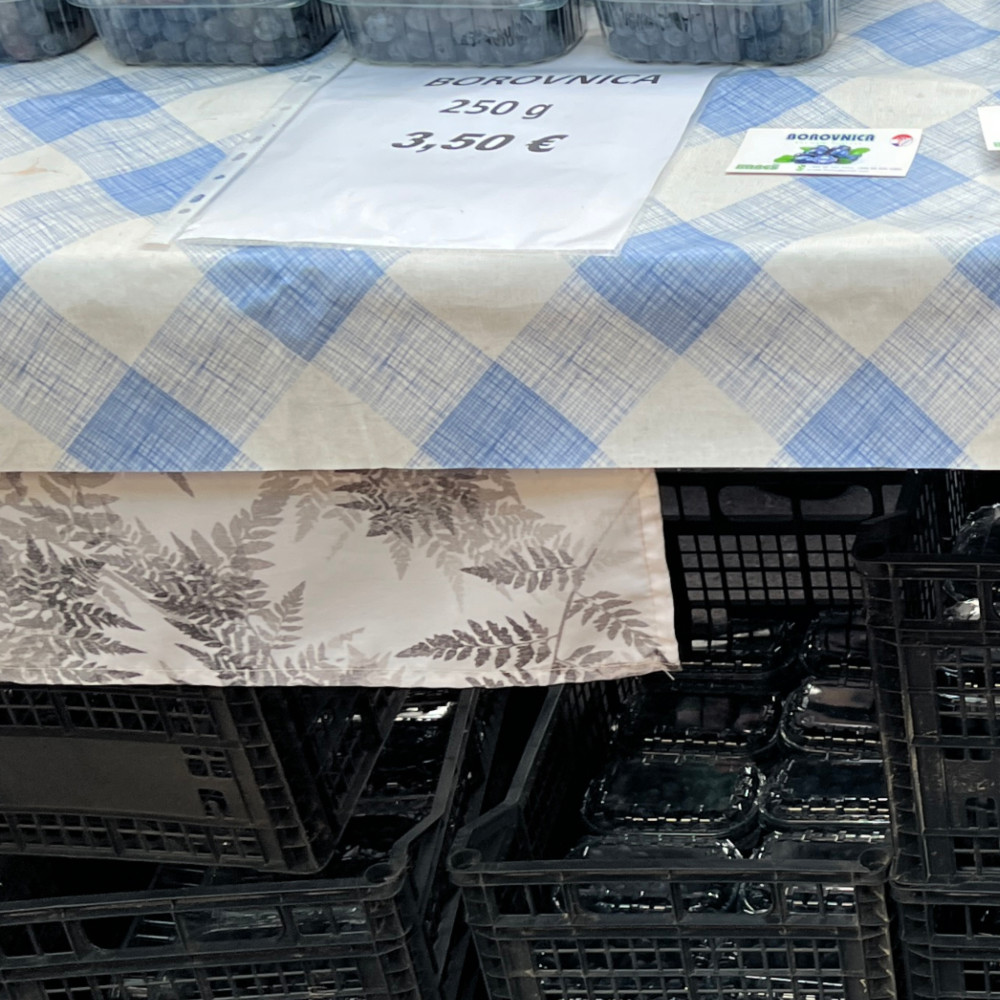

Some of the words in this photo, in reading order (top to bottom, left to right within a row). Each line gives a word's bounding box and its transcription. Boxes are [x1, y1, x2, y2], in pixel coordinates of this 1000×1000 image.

[424, 74, 662, 87] BOROVNICA
[439, 99, 519, 115] 250
[522, 104, 553, 120] g
[391, 132, 515, 152] 3,50
[526, 134, 568, 152] €
[786, 133, 875, 142] BOROVNICA
